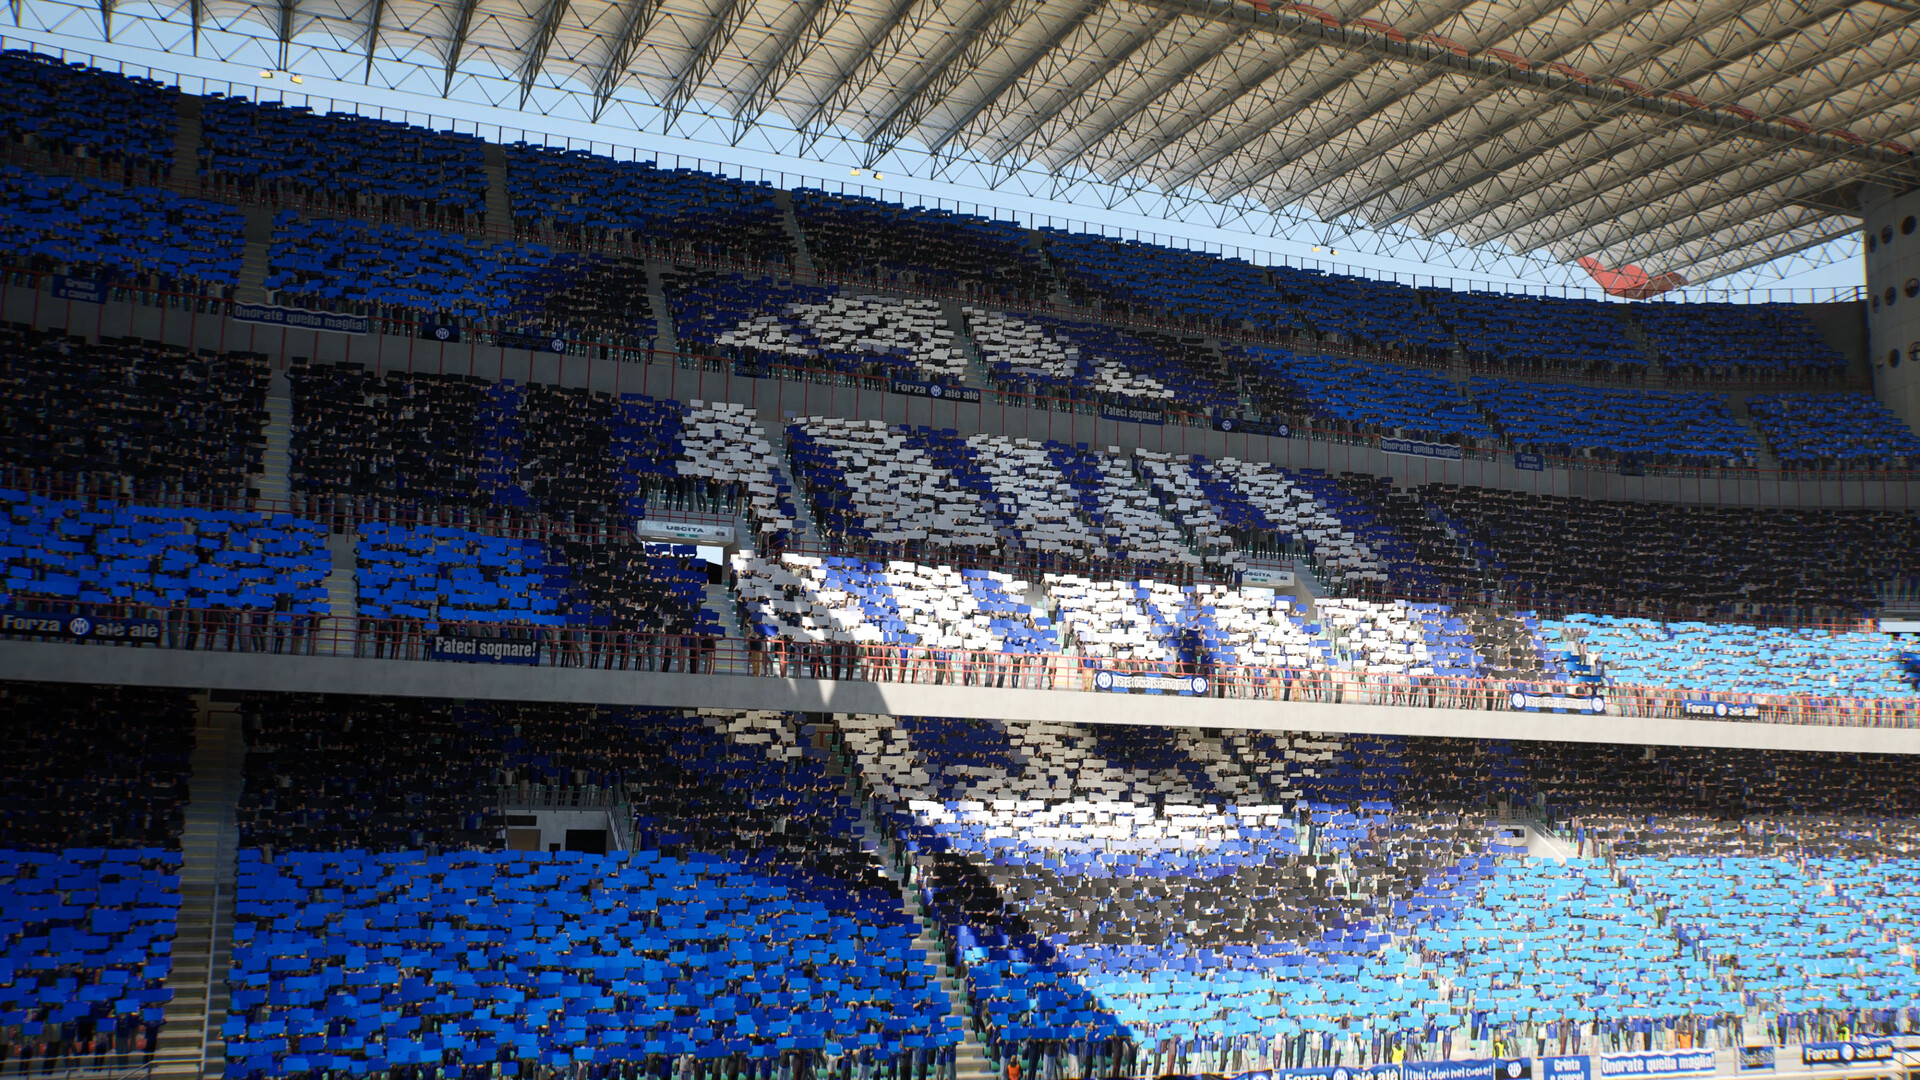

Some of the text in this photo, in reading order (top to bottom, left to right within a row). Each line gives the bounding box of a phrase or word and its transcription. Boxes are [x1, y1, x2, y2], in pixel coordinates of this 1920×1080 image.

[235, 305, 367, 330] Onorate quella maglia!
[895, 381, 926, 394] Forza
[1103, 404, 1162, 422] Fateci sognare!
[1412, 445, 1434, 455] quella
[666, 525, 704, 533] USCITA
[1, 614, 159, 638] Forza alè alè
[435, 636, 537, 660] Fateci sognare!
[1686, 702, 1714, 714] Forza
[1806, 1047, 1839, 1061] Forza
[1554, 1058, 1580, 1072] Grinta
[1602, 1053, 1715, 1073] Onorate quella maglia!
[1451, 1067, 1465, 1079] nel
